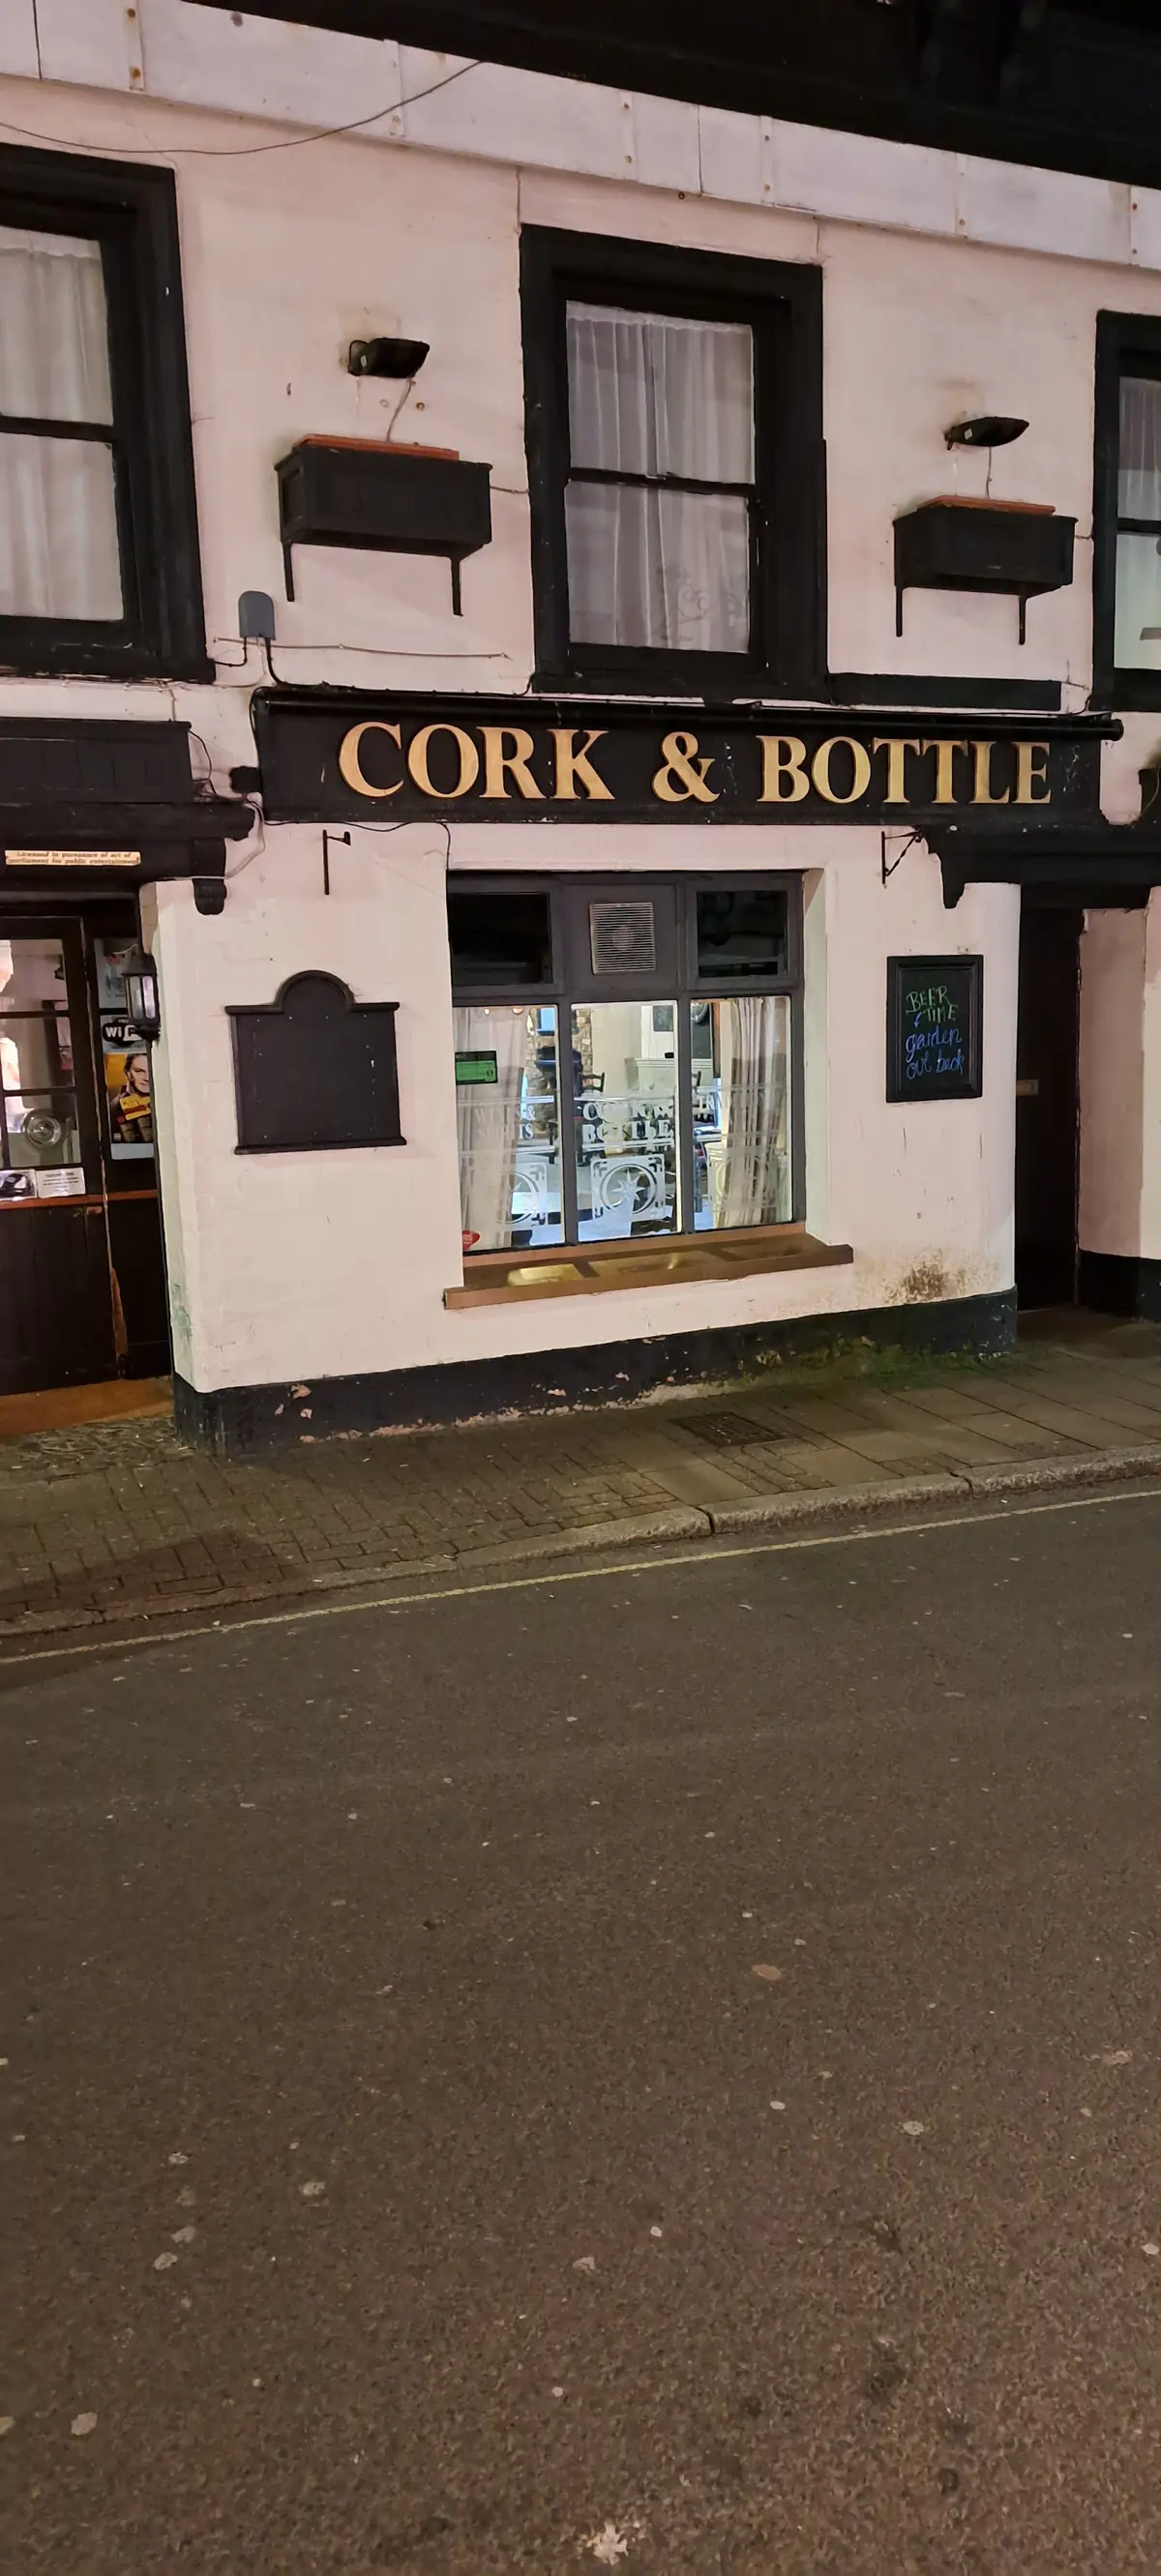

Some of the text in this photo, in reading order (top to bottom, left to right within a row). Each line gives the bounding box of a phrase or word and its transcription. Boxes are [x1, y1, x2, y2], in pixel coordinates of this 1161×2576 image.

[339, 722, 1052, 804] CORK & BOTTLE
[906, 985, 952, 1015] BEER
[921, 1003, 958, 1023] TIME
[906, 1024, 963, 1063] garden
[582, 1119, 674, 1142] BOTLE
